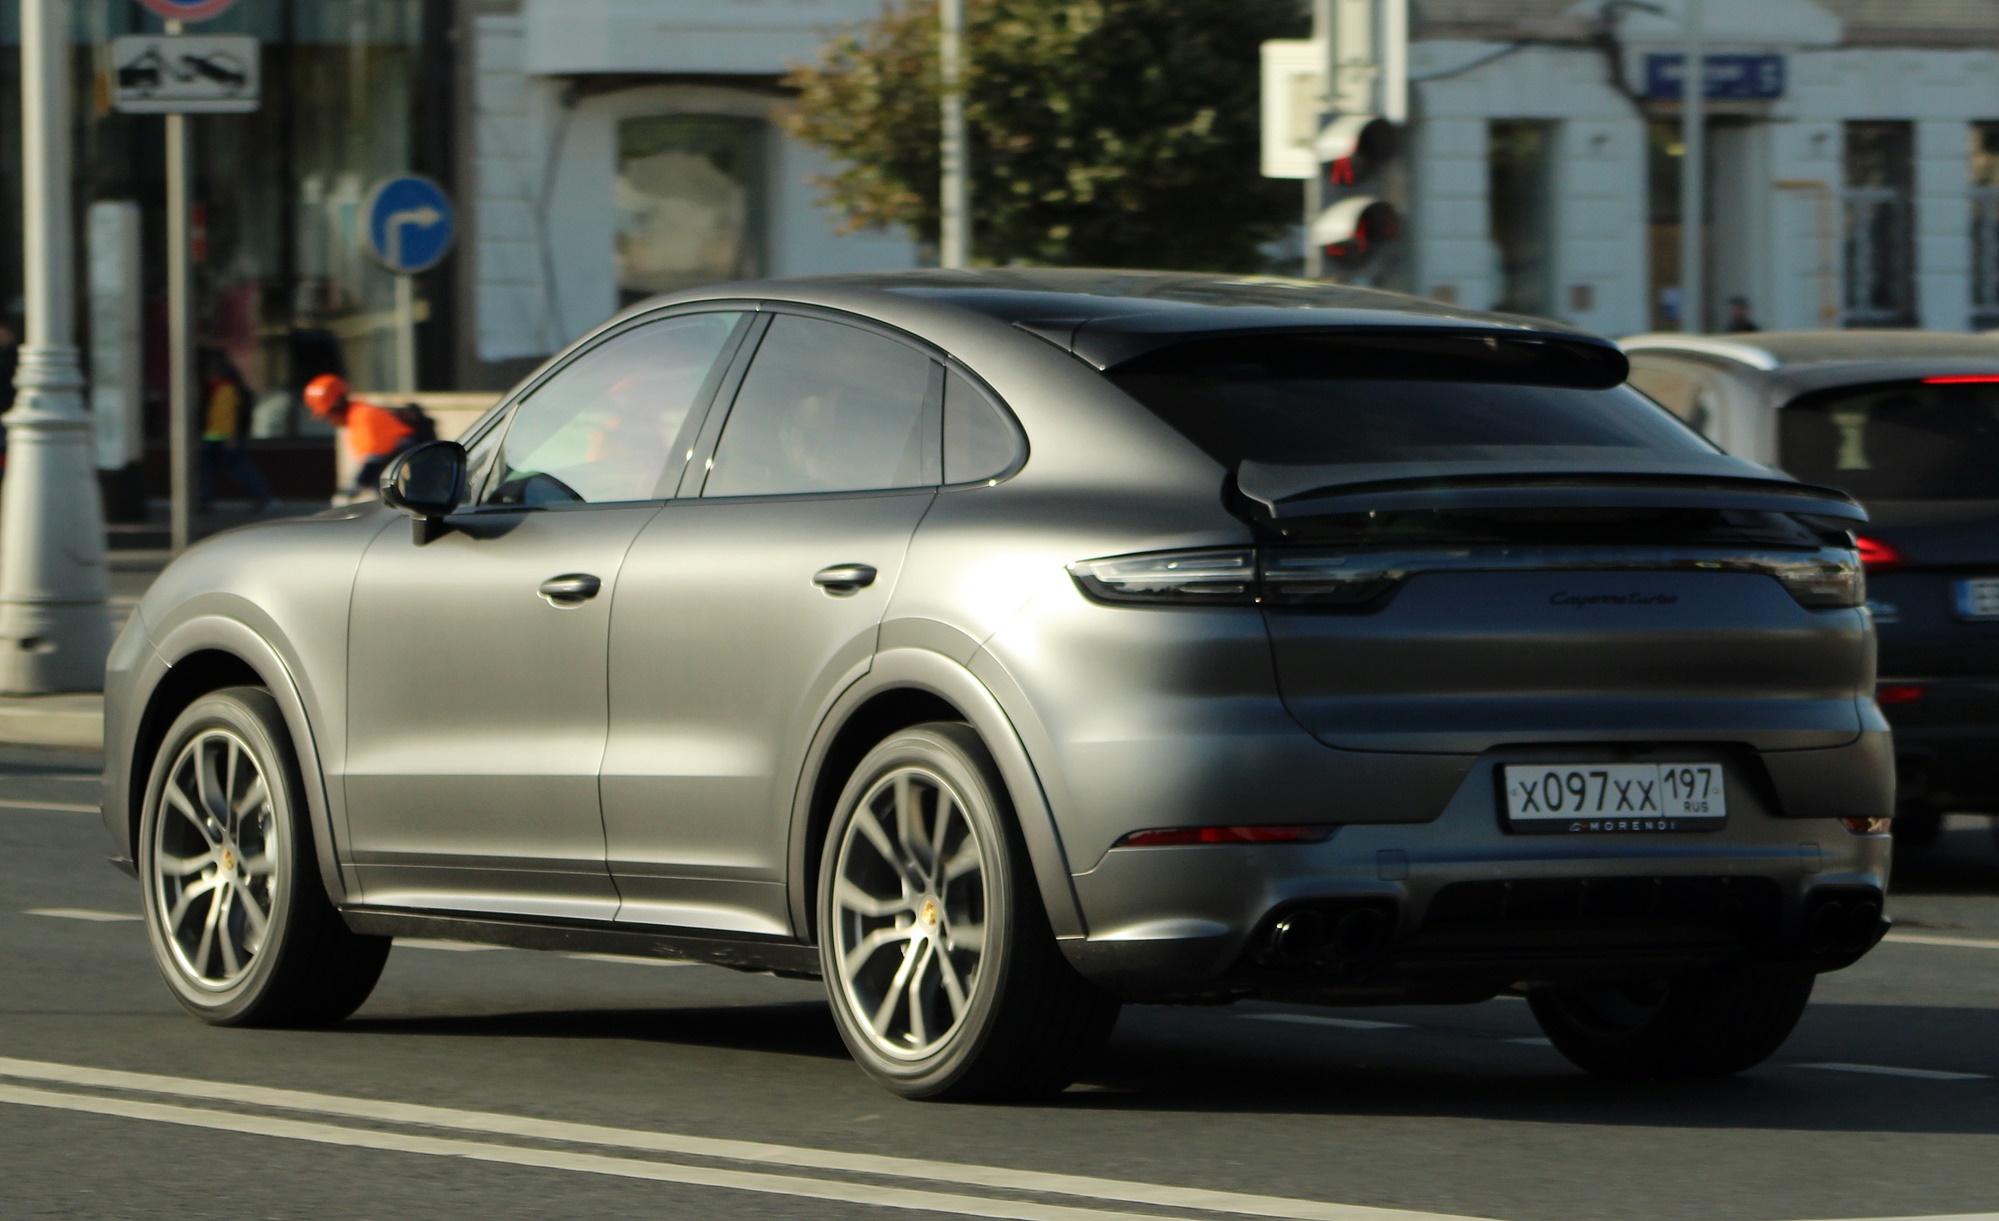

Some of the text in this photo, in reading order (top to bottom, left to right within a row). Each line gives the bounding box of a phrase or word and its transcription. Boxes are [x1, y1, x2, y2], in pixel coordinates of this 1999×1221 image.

[1518, 768, 1712, 813] X097XX 197
[1683, 801, 1709, 813] RUS
[1589, 821, 1676, 831] MORENDI
